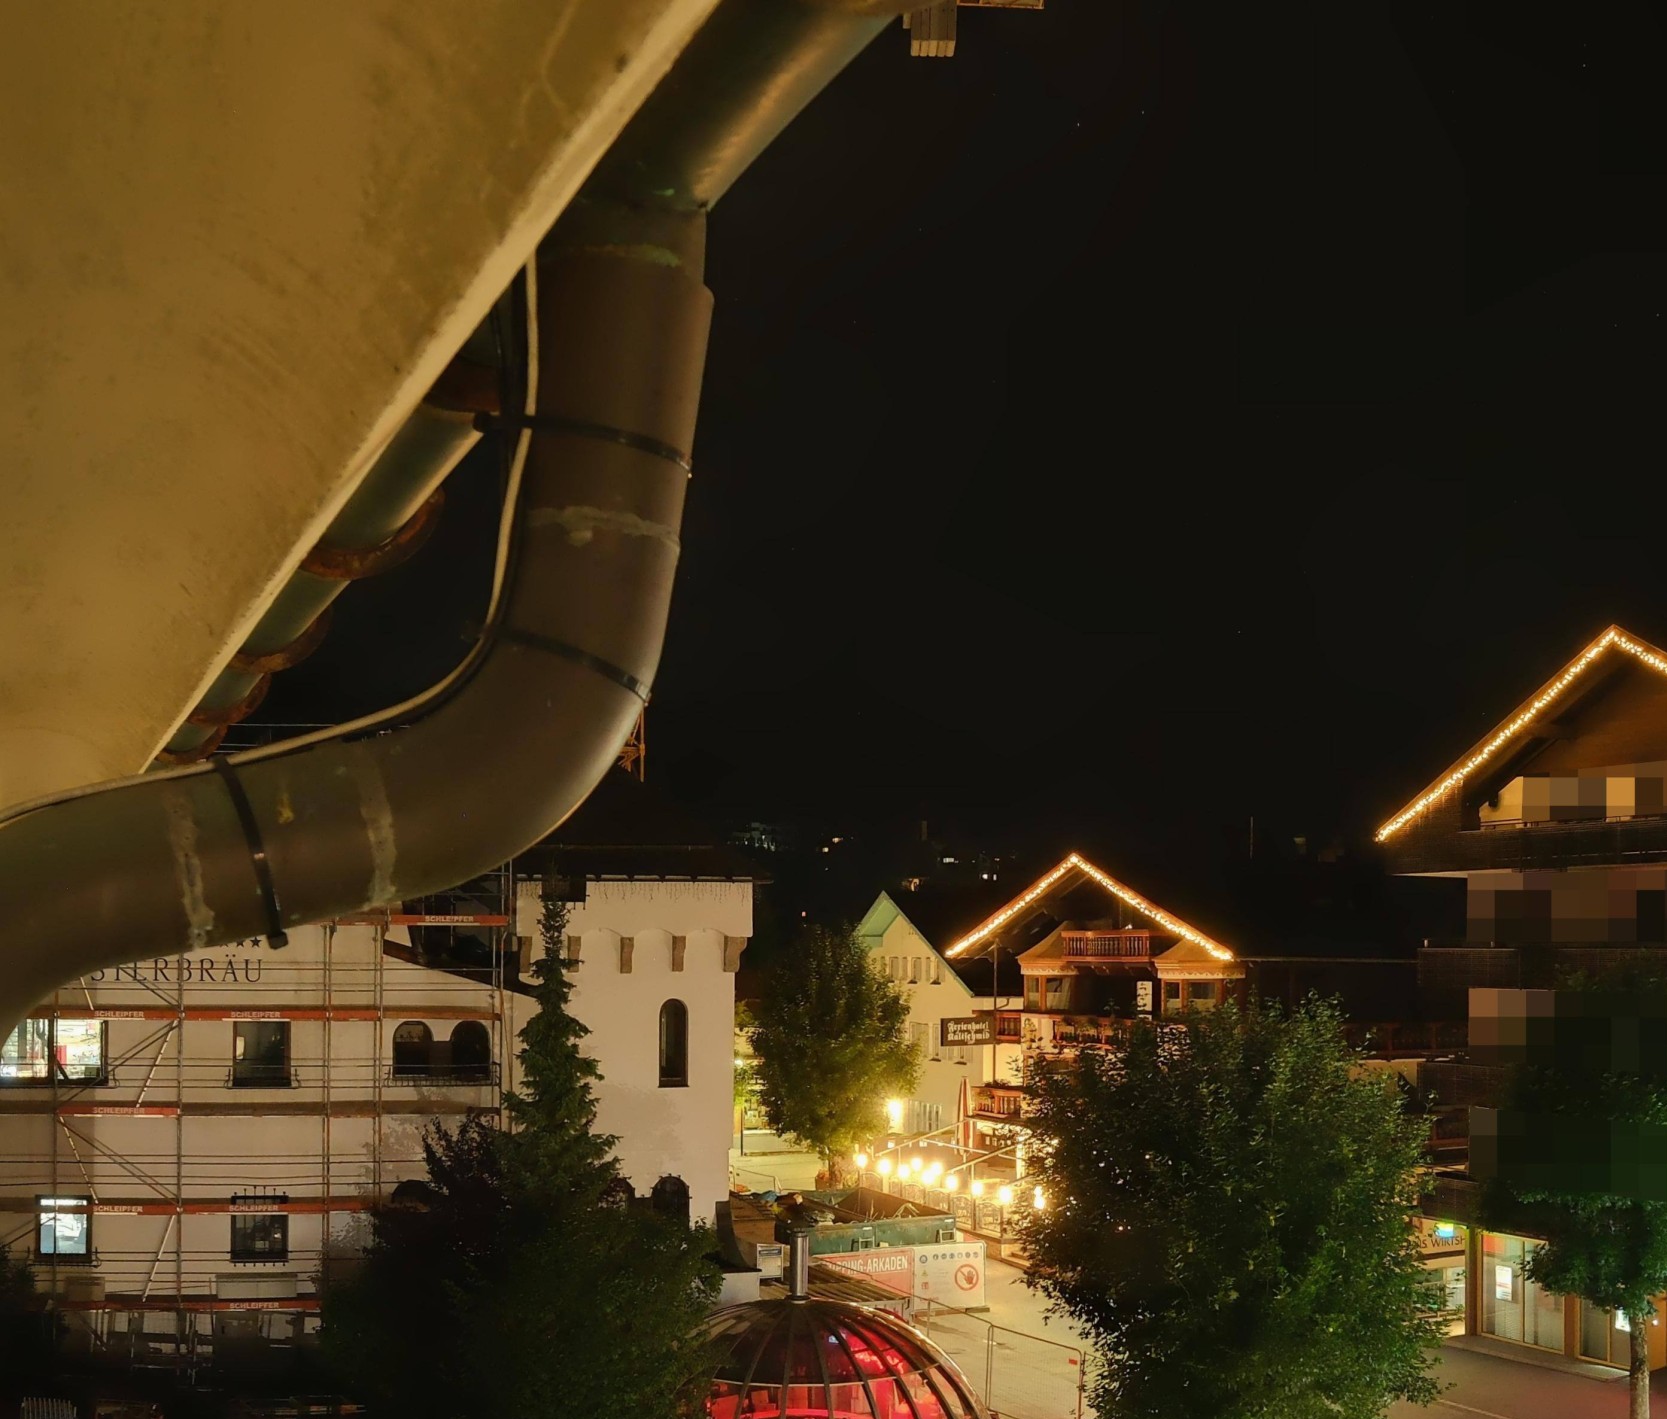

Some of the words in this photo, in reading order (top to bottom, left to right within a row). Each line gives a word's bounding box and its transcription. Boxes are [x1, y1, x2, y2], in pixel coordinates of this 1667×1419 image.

[94, 1010, 144, 1018] SCHLEIPFER
[93, 1106, 145, 1114] SCHLEIPFER
[93, 1205, 143, 1213] SCHLEIPFER
